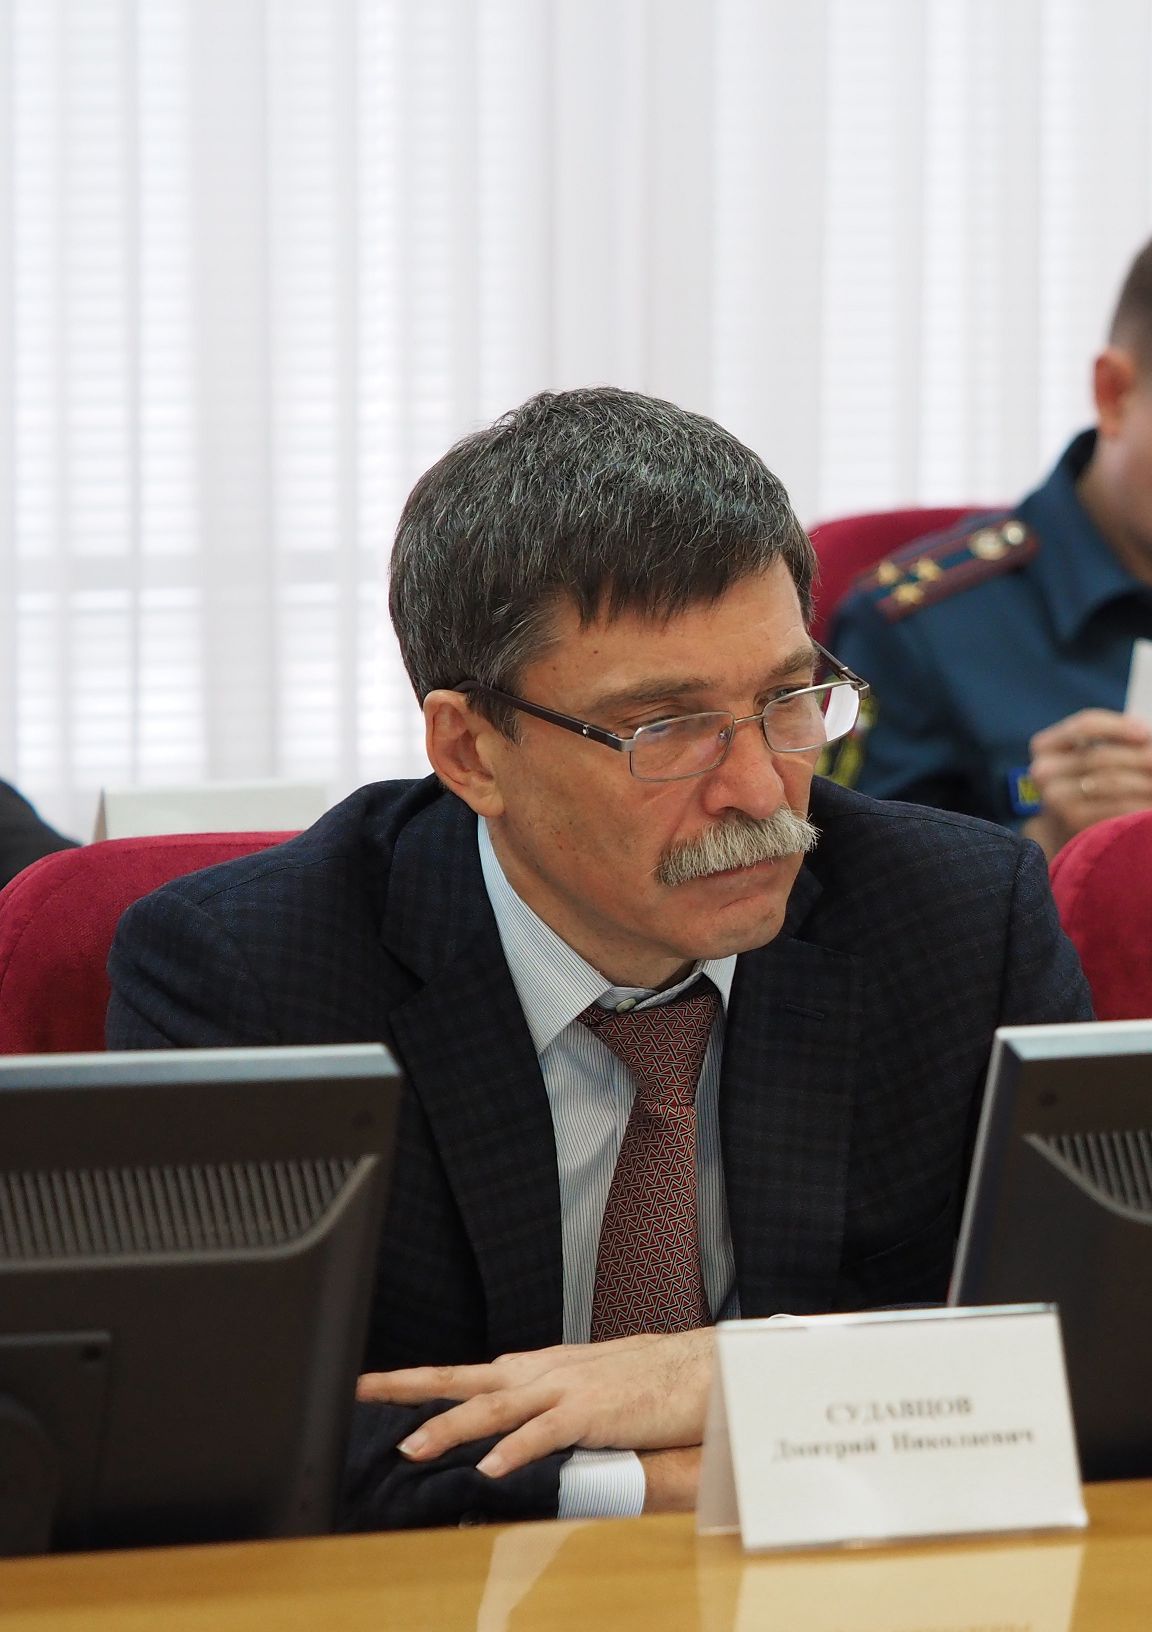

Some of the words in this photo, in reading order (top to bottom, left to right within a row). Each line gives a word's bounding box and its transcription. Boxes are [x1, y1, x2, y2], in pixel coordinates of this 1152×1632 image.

[825, 1396, 973, 1426] СУДАВЦОВ
[771, 1435, 878, 1464] Дмитрий
[892, 1428, 1035, 1454] Николаевич
